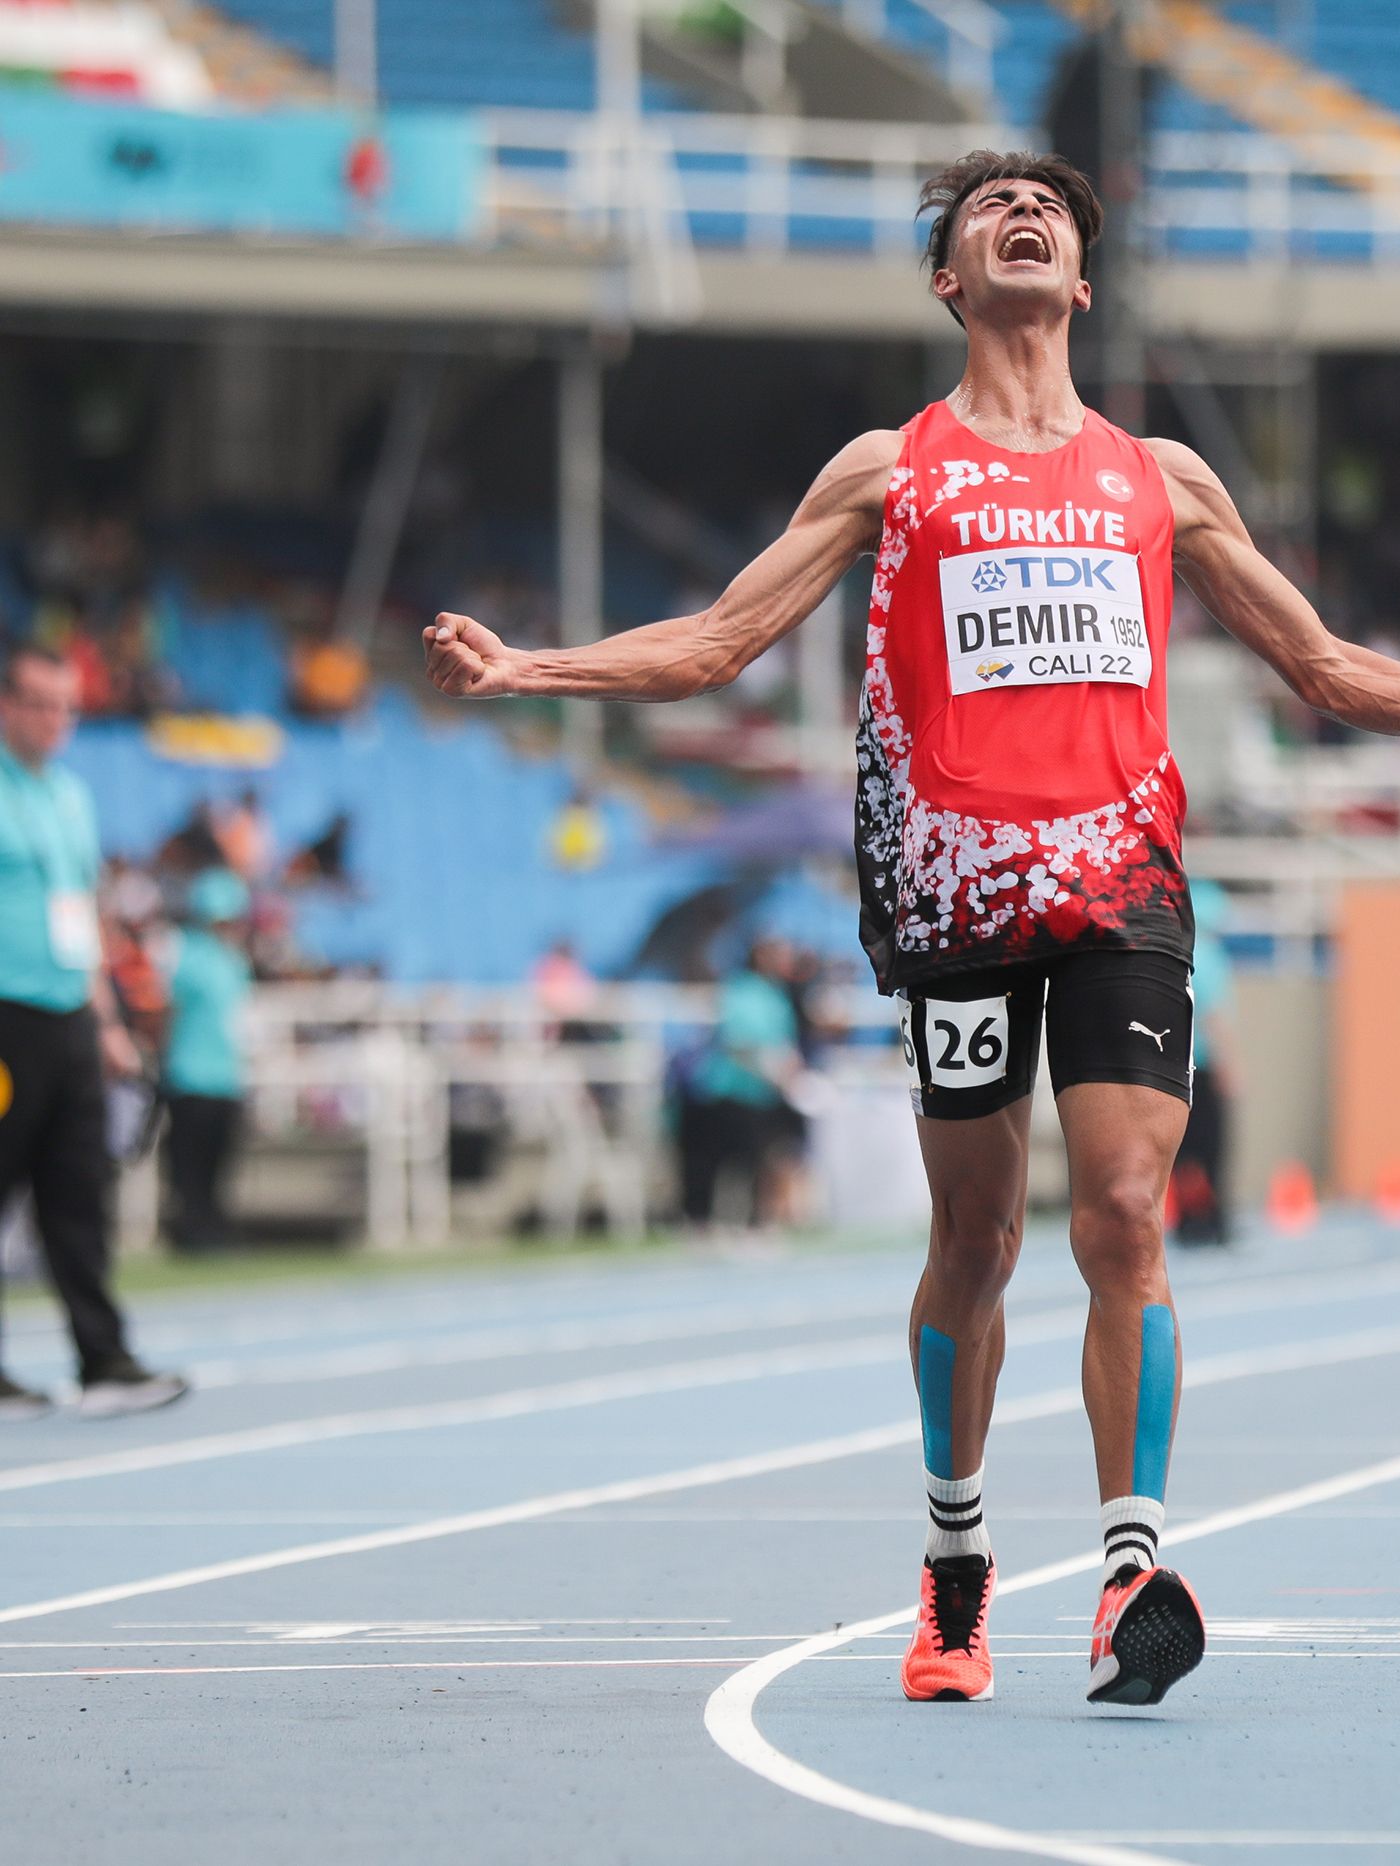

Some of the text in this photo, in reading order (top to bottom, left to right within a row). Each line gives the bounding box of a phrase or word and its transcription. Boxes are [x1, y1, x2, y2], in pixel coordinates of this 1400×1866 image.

[951, 501, 1125, 547] TÜRKİYE
[1005, 556, 1118, 592] TDK
[957, 603, 1145, 653] DEMIR 1952
[1028, 653, 1134, 677] CALI 22
[934, 1016, 1003, 1071] 26
